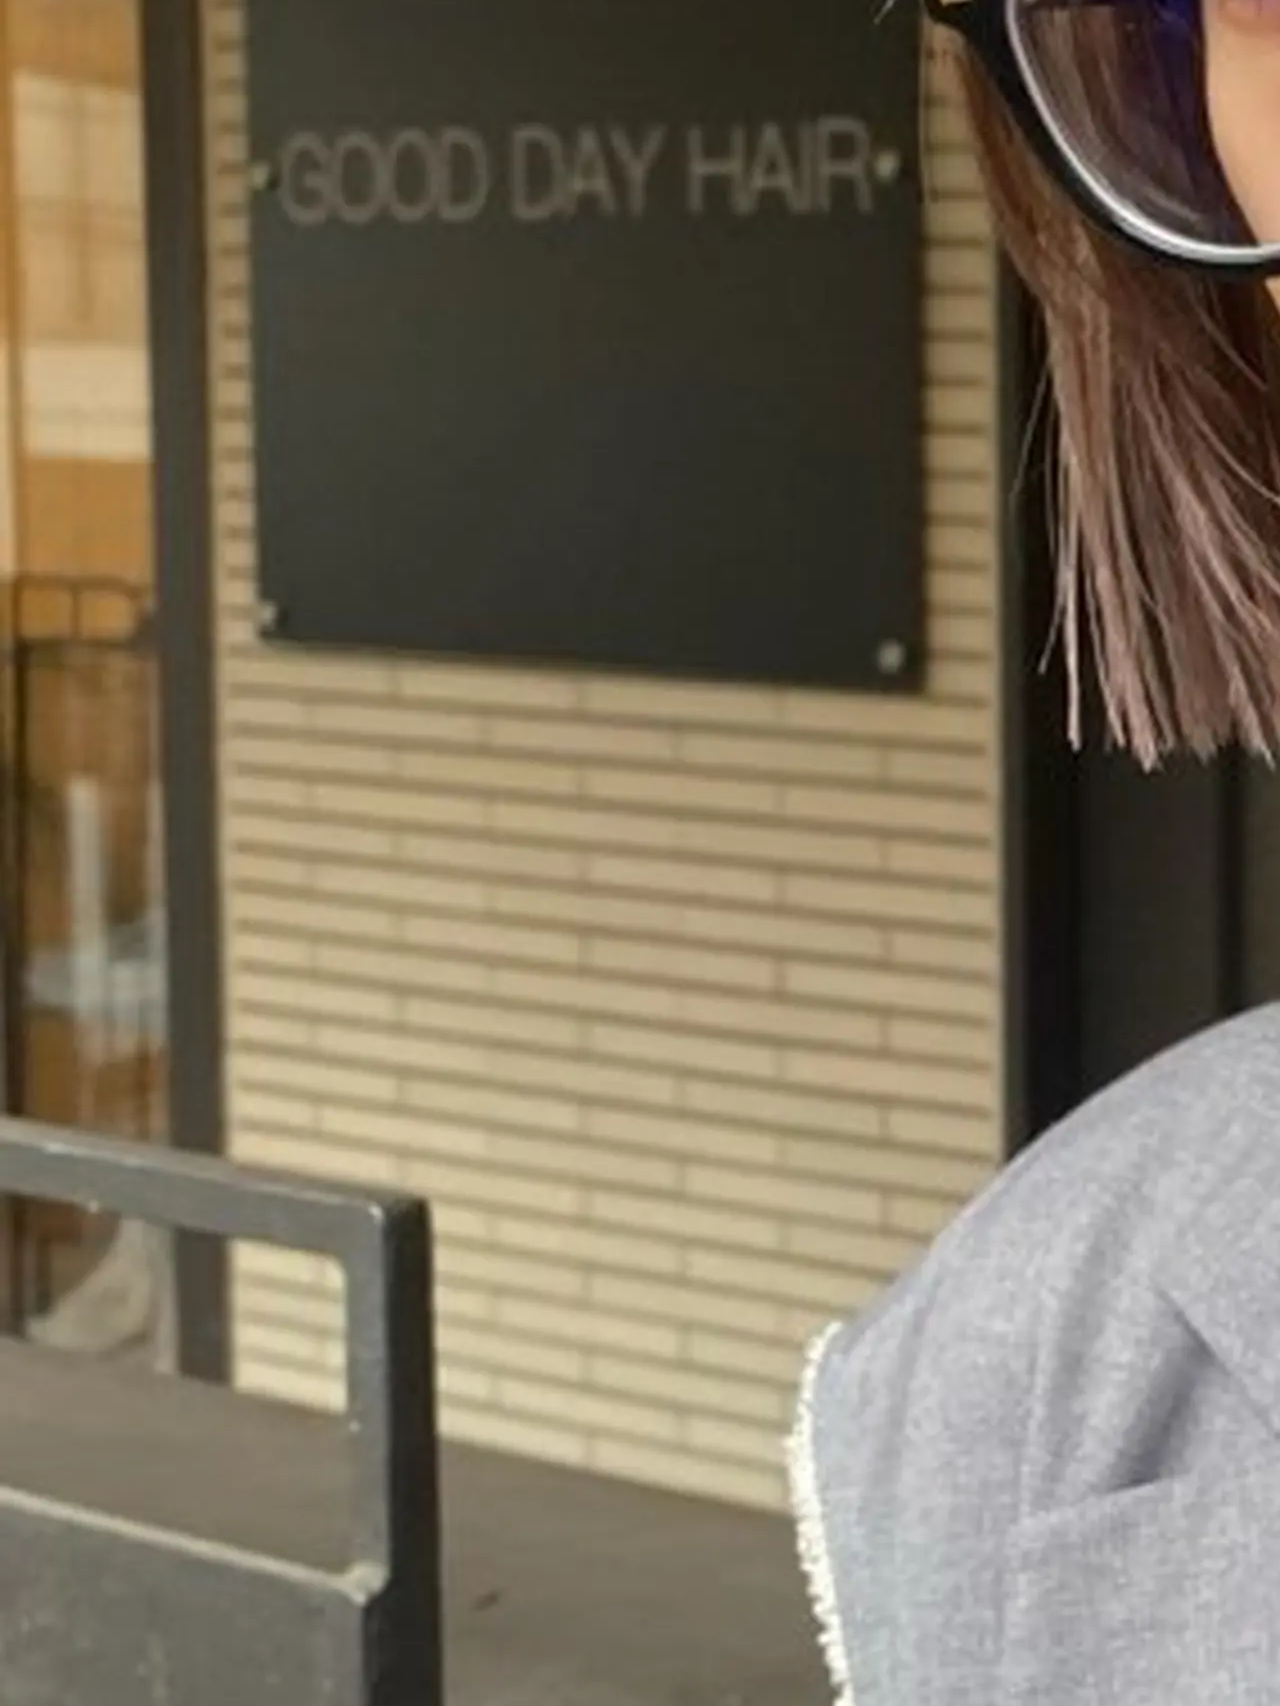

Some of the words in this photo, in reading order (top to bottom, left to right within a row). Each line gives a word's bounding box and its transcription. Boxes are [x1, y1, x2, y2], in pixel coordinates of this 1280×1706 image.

[281, 128, 489, 224] GOOD
[510, 123, 668, 219] DAY
[688, 116, 873, 215] HAIR
